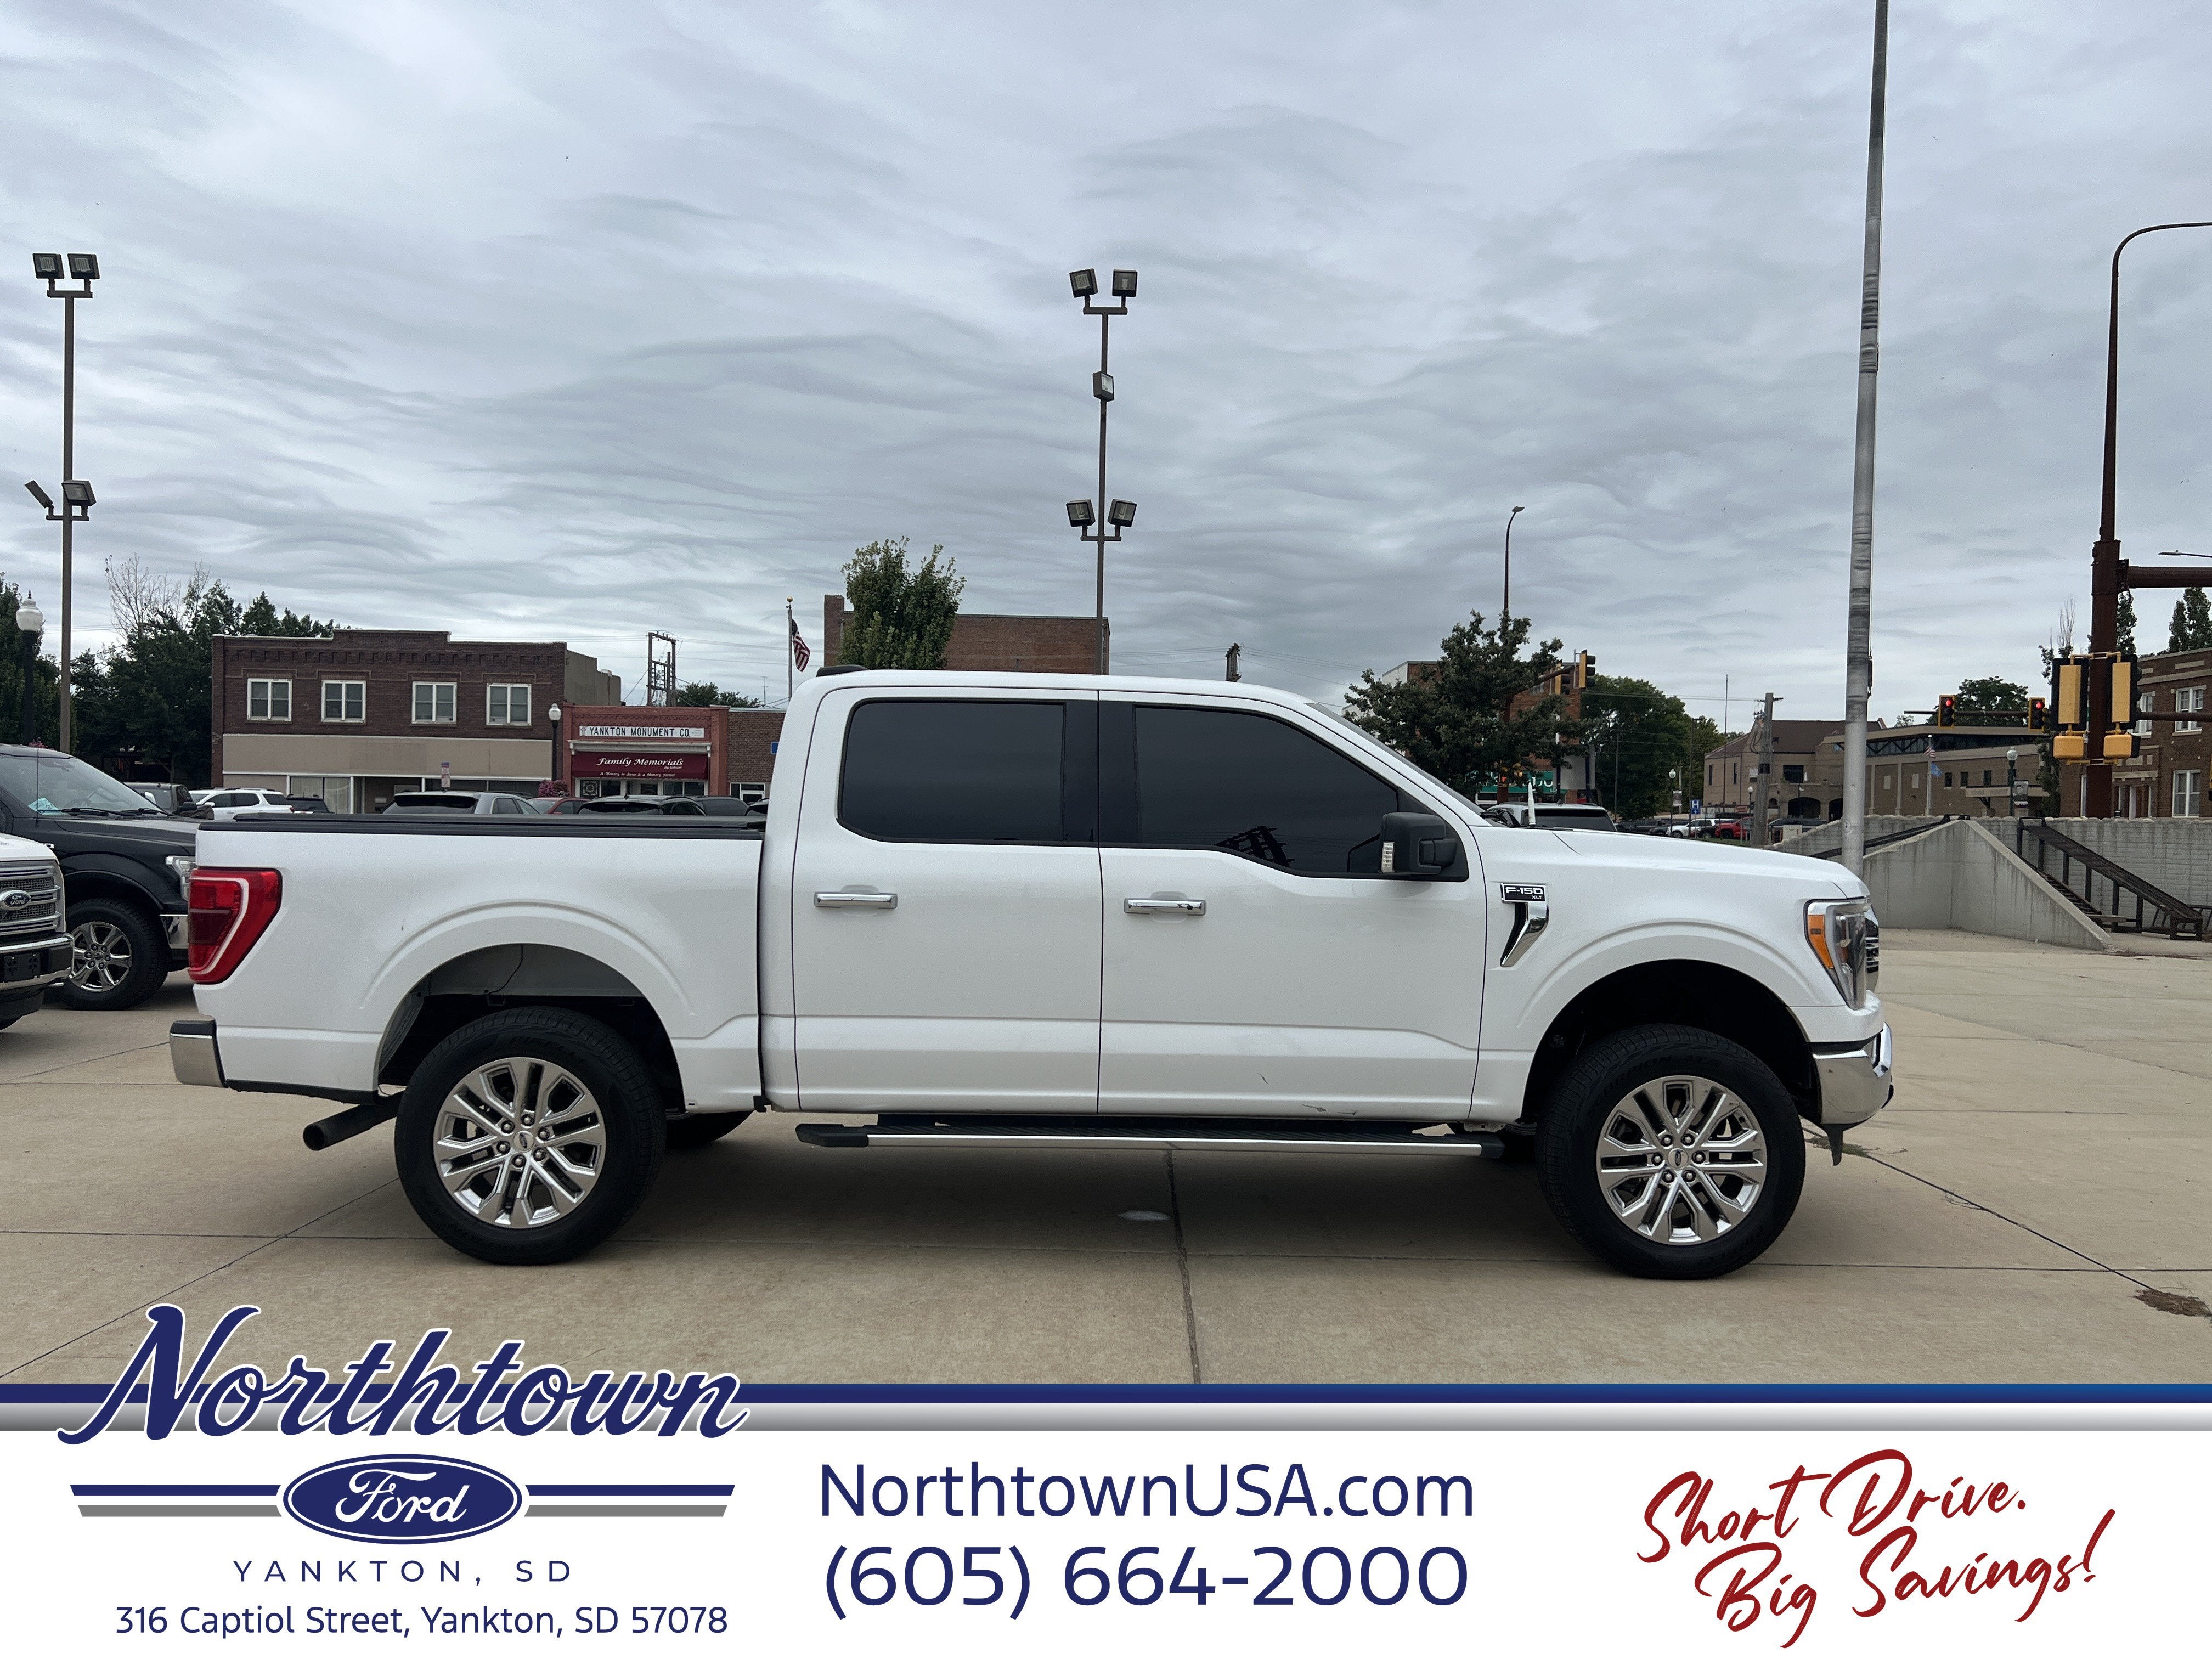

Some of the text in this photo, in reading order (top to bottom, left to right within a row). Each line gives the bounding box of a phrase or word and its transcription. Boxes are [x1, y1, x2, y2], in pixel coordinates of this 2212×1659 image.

[590, 727, 626, 736] YANKTON
[630, 727, 675, 737] MONUMENT
[680, 728, 690, 737] CO.
[596, 757, 684, 767] Family Memorials
[1691, 800, 1699, 809] H
[1505, 887, 1543, 895] F-150
[10, 895, 26, 905] Ford
